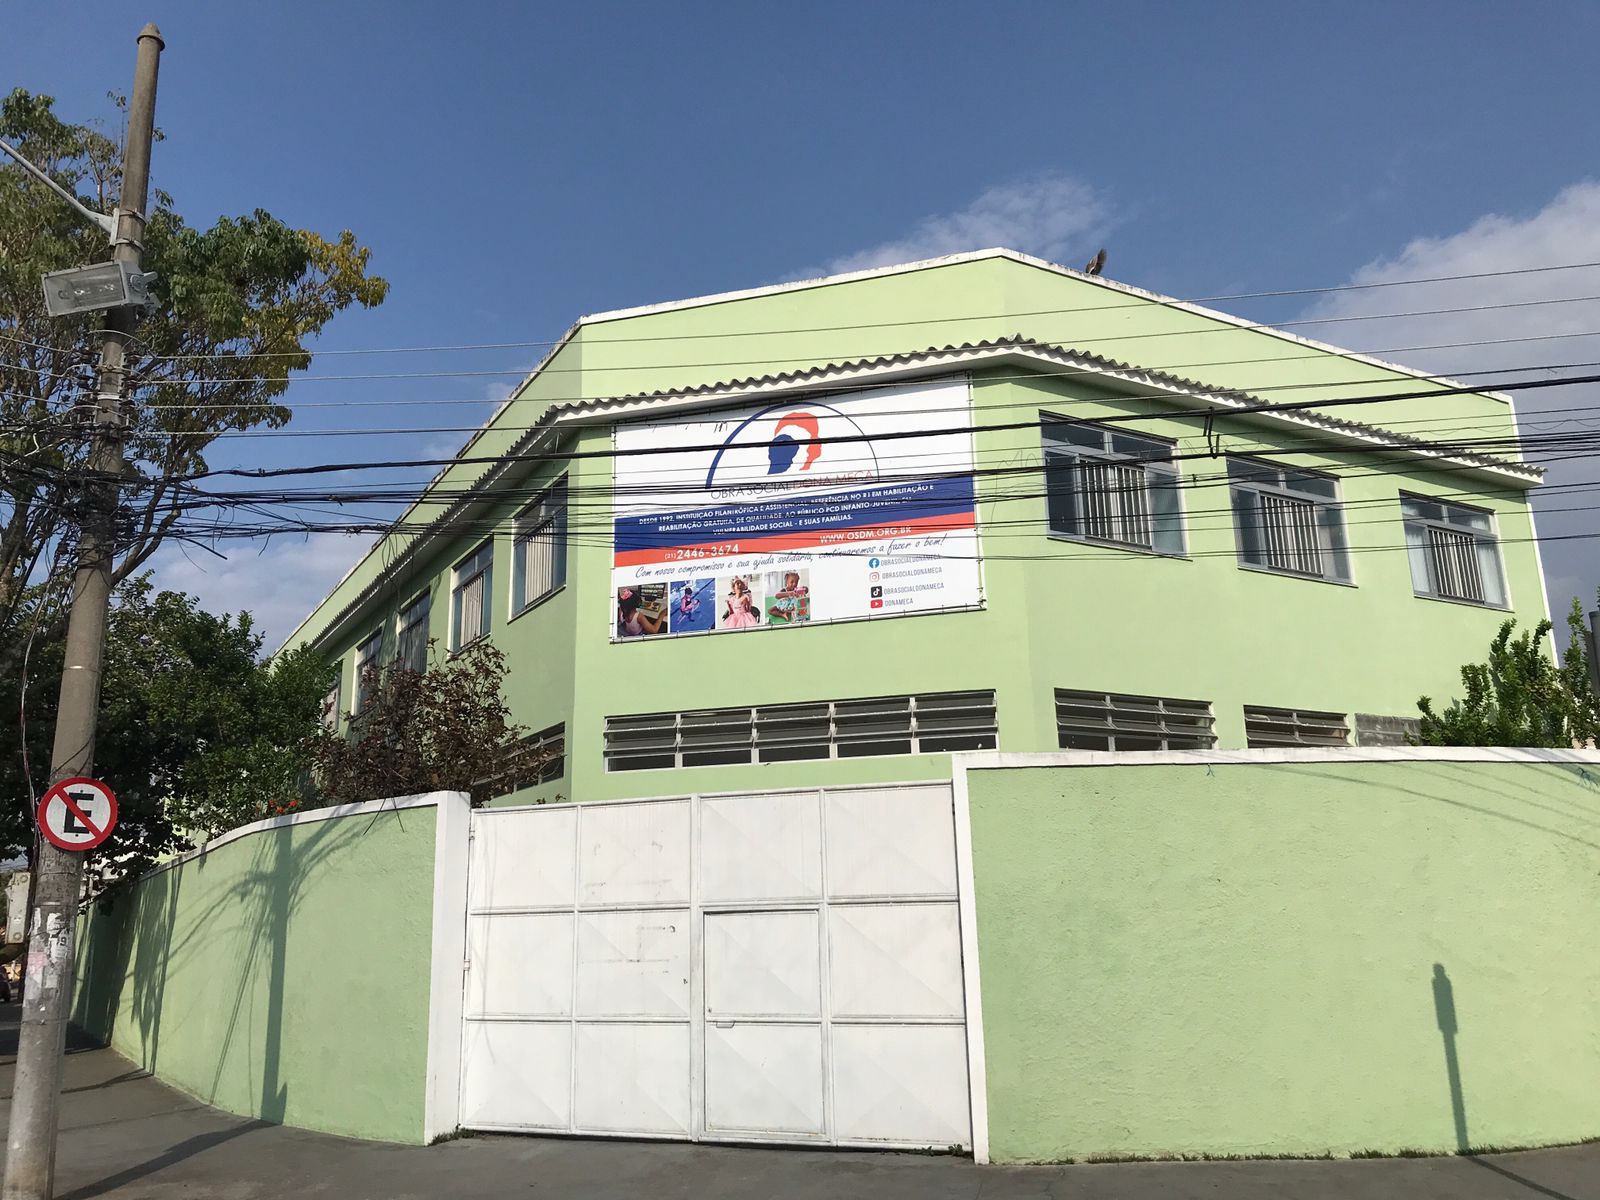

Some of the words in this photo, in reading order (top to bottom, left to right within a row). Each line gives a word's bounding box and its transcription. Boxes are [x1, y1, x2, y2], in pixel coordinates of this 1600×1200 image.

[639, 517, 657, 525] DESDE
[883, 483, 928, 496] HABILITAÇÃO
[711, 487, 744, 500] OBRA
[659, 521, 702, 532] REABILITAÇÃO
[785, 511, 796, 519] AO
[769, 519, 793, 529] SOCIAL
[804, 517, 820, 525] SUAS
[821, 513, 853, 523] FAMÍLIAS.
[636, 566, 652, 579] Com
[655, 568, 675, 576] nosso
[678, 561, 725, 577] compromisso
[736, 560, 750, 568] sua
[753, 554, 775, 571] ajuda
[887, 538, 911, 556] fazer
[924, 533, 948, 547] bem!
[677, 544, 739, 560] 2446-3674
[64, 792, 94, 834] E
